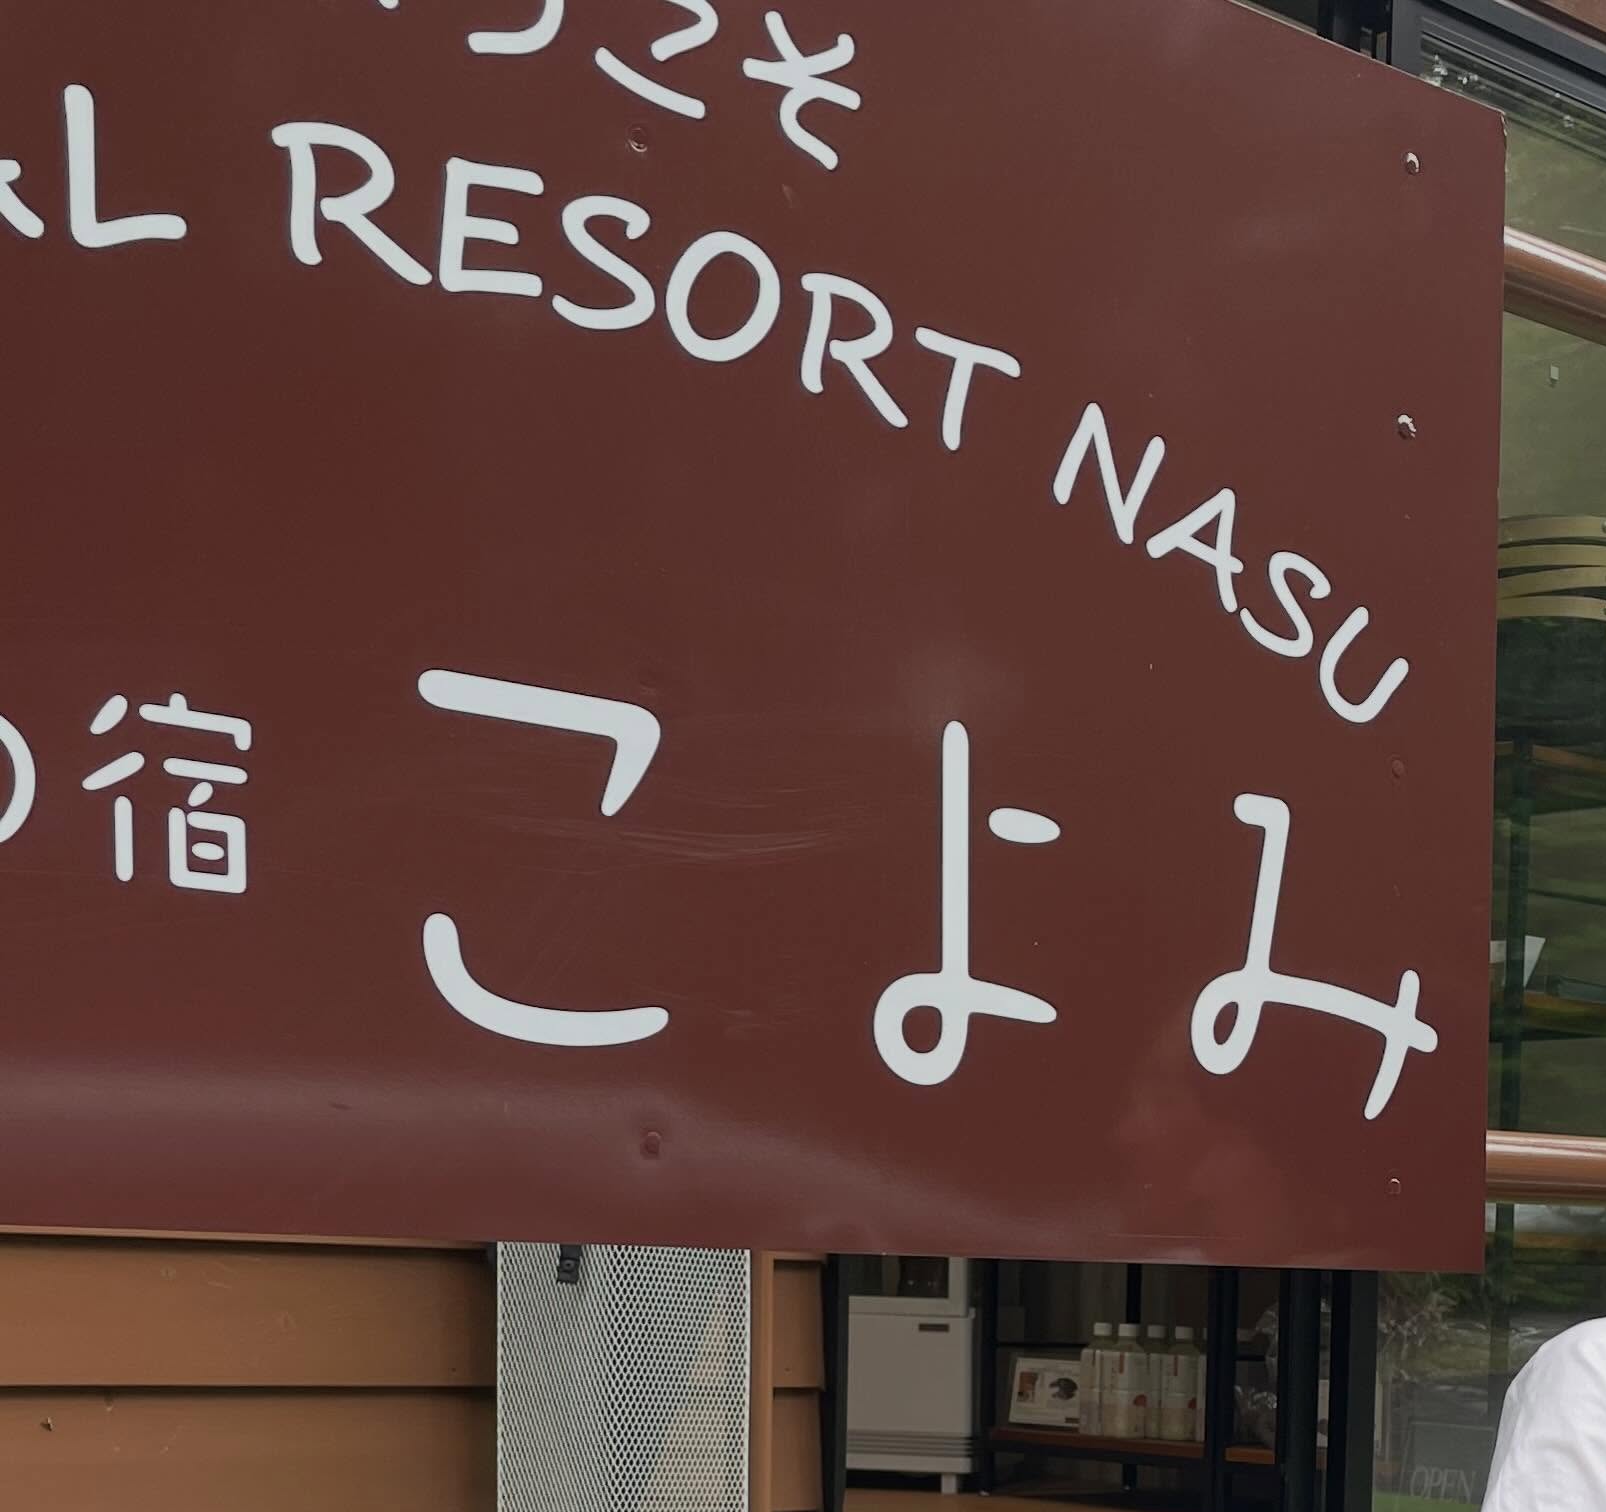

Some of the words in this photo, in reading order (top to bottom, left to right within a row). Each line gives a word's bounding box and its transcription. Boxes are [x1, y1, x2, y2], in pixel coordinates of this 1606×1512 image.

[378, 0, 861, 171] こそ
[0, 84, 187, 248] L
[271, 121, 1021, 451] RESORT
[1053, 402, 1409, 723] NASU
[0, 692, 252, 894] 宿
[417, 669, 1438, 1120] こよみ
[1409, 1465, 1477, 1504] OPEN
